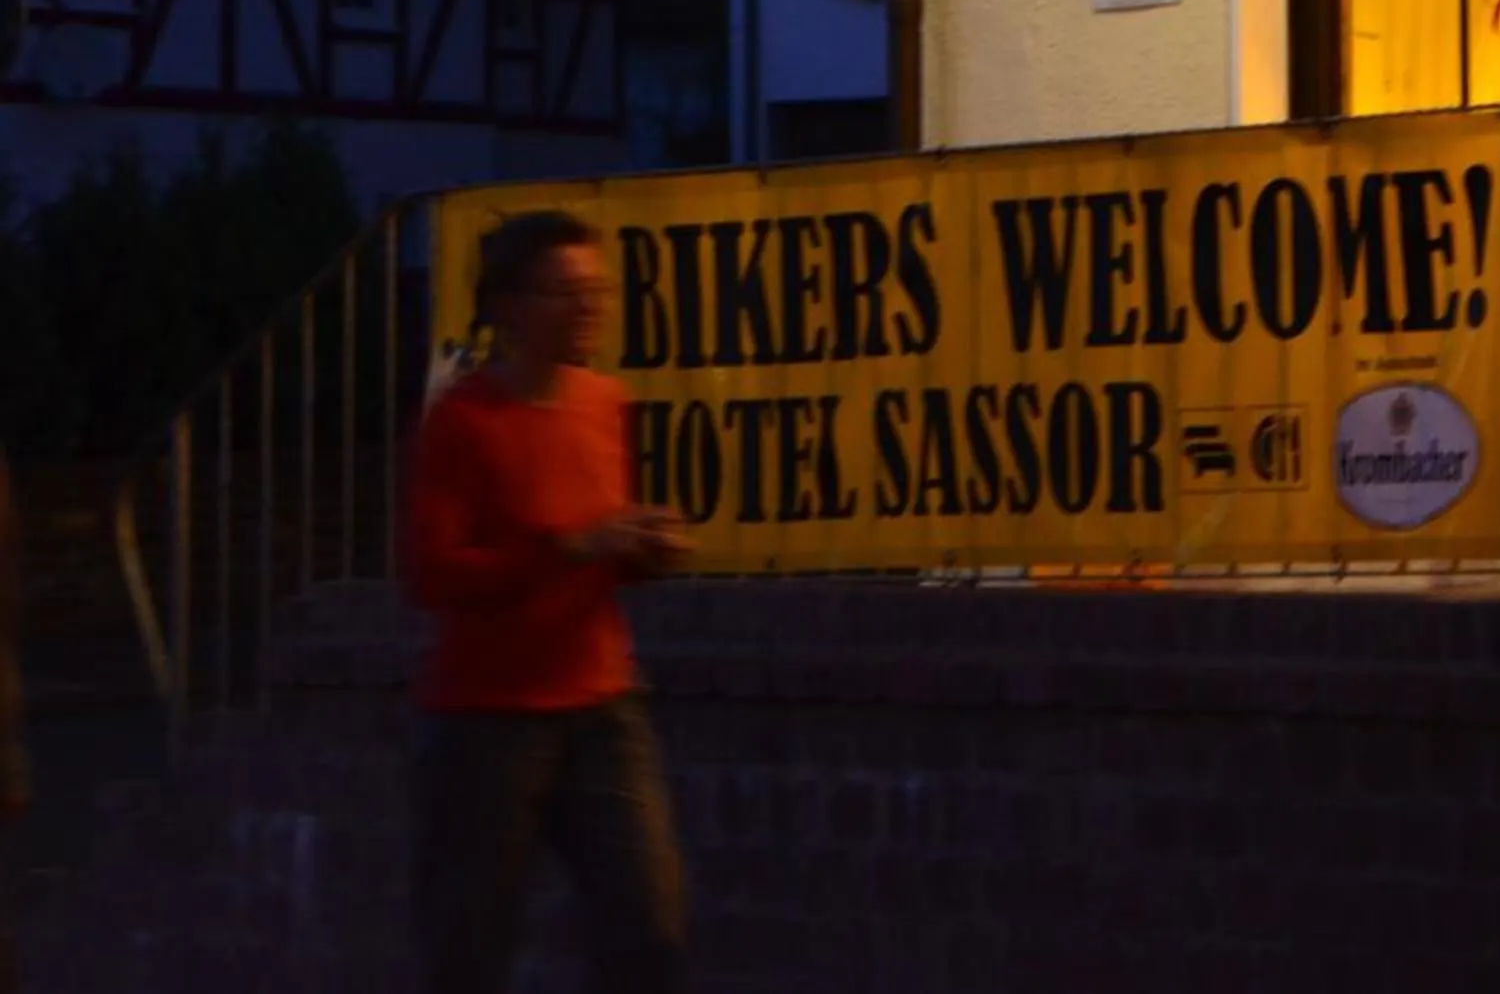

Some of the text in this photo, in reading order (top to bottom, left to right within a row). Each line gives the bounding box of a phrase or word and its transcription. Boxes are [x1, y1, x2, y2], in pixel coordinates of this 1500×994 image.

[618, 164, 1494, 370] BIKERS WELCOME!
[630, 381, 1164, 525] HOTEL SASSOR
[1340, 439, 1469, 487] Krombacher
